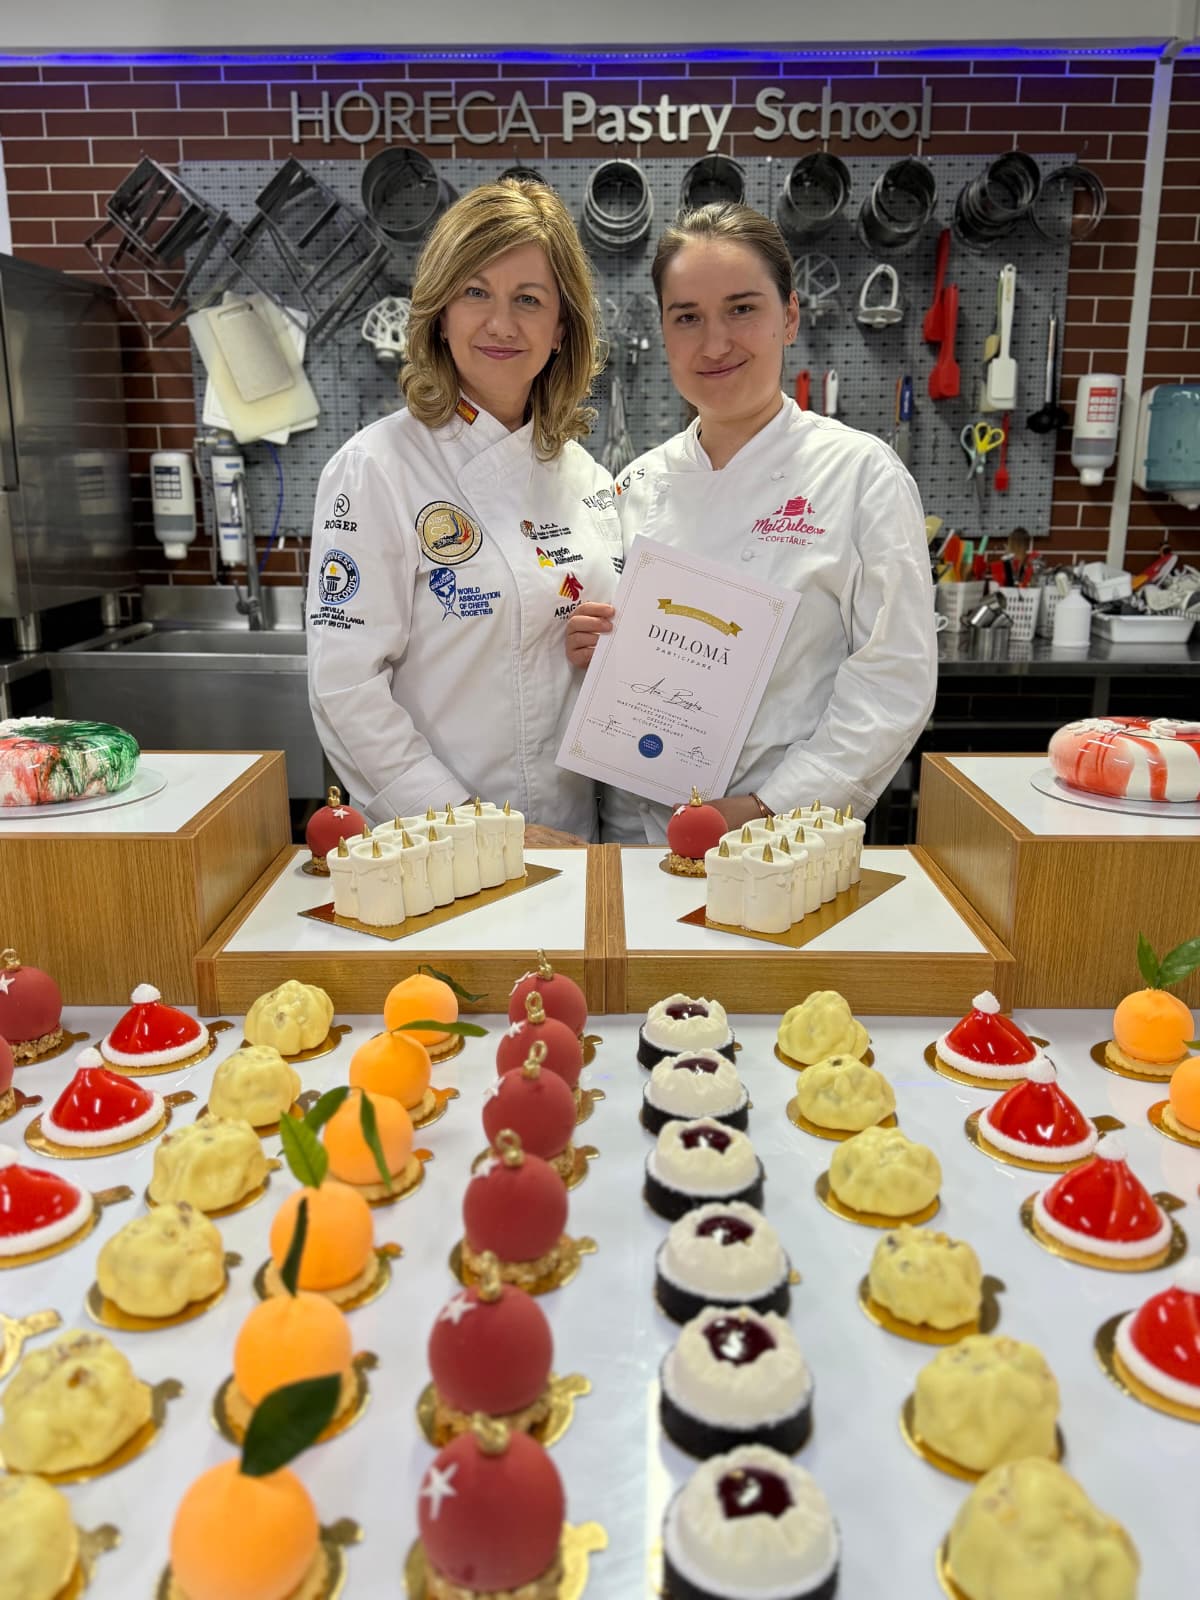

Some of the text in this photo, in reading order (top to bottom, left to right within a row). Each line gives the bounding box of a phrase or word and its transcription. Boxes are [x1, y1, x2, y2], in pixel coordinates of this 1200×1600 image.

[290, 86, 932, 151] HORECA Pastry School
[324, 519, 358, 532] ROGER
[765, 535, 807, 546] COFETĂRIE
[546, 546, 570, 559] Aragón
[457, 586, 480, 595] WORLD
[458, 591, 501, 602] ASSOCIATION
[468, 601, 490, 609] CHEFS
[554, 600, 582, 618] ARAG
[461, 608, 493, 616] SOCIETIES
[648, 624, 730, 665] DIPLOMĂ
[655, 646, 712, 671] PARTICIPARE
